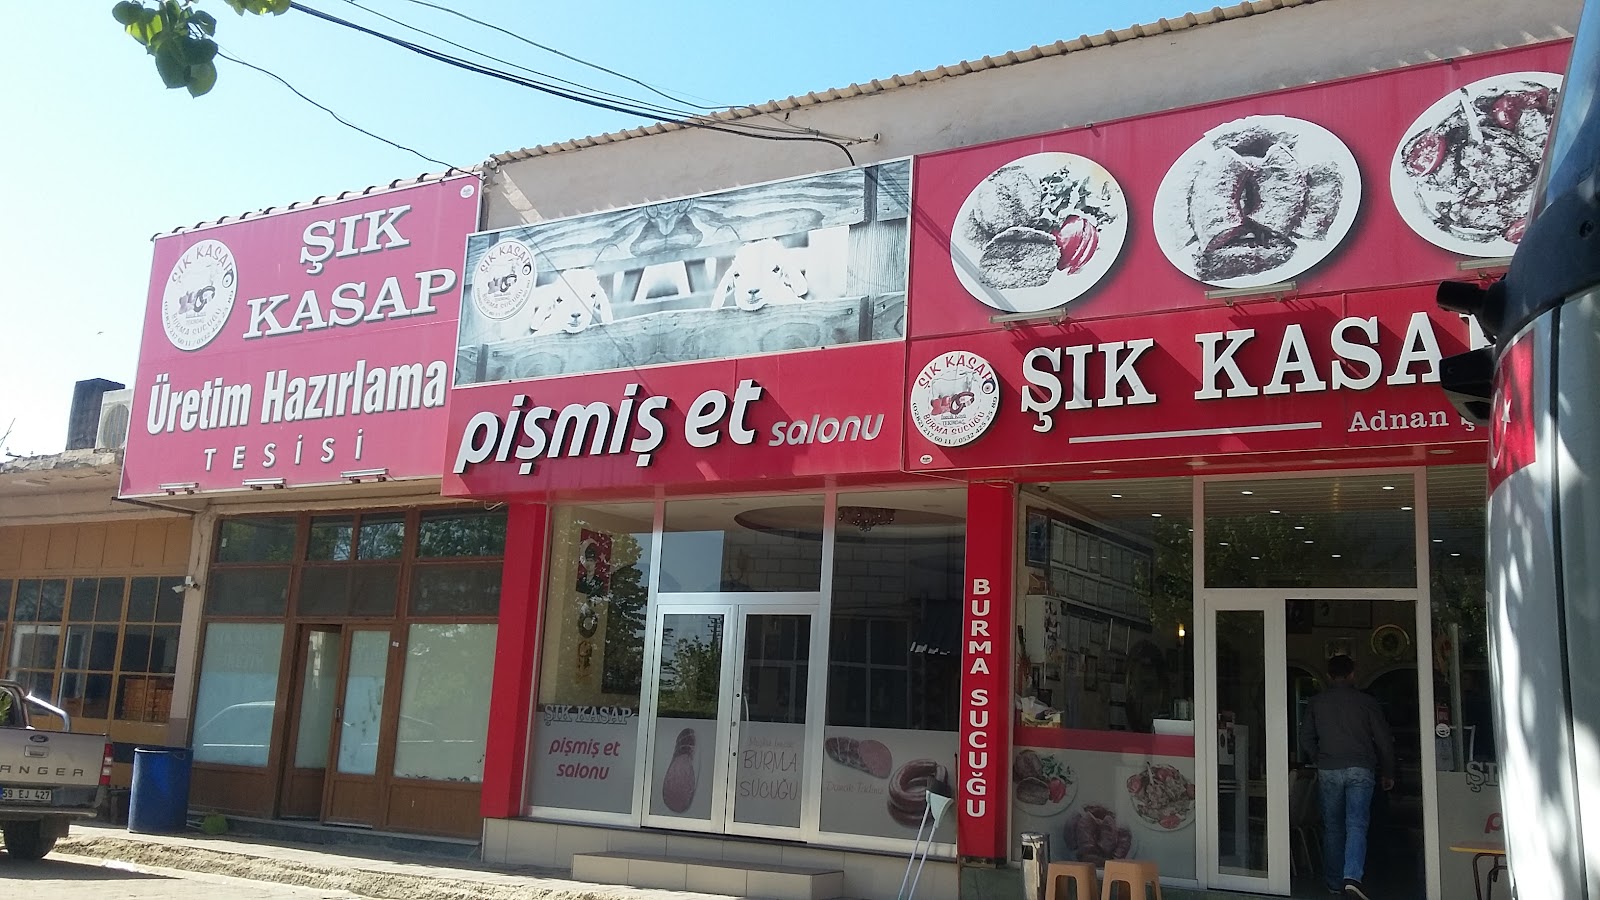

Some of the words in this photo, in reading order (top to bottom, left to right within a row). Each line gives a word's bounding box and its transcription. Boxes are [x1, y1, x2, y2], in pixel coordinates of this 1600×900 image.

[300, 204, 411, 274] ŞIK
[242, 268, 458, 341] KASAP
[147, 373, 252, 436] Üretim
[260, 358, 448, 424] Hazırlama
[1020, 337, 1156, 433] ŞIK
[453, 383, 668, 475] pişmiş
[684, 378, 763, 448] et
[768, 413, 885, 447] salonu
[1347, 410, 1449, 432] Adnan
[204, 428, 364, 472] TESİSİ
[968, 578, 992, 675] BURMA
[544, 704, 573, 727] ŞIK
[575, 704, 632, 725] KASAP
[548, 737, 600, 758] pişmiş
[603, 741, 621, 756] et
[742, 750, 797, 773] BURMA
[966, 689, 989, 818] SUCUĞU
[0, 764, 84, 776] ANGER
[556, 763, 610, 780] salonu
[1466, 760, 1499, 793] ŞI
[19, 789, 30, 799] EJ
[35, 791, 50, 800] 427
[740, 778, 799, 800] SUCUĞU
